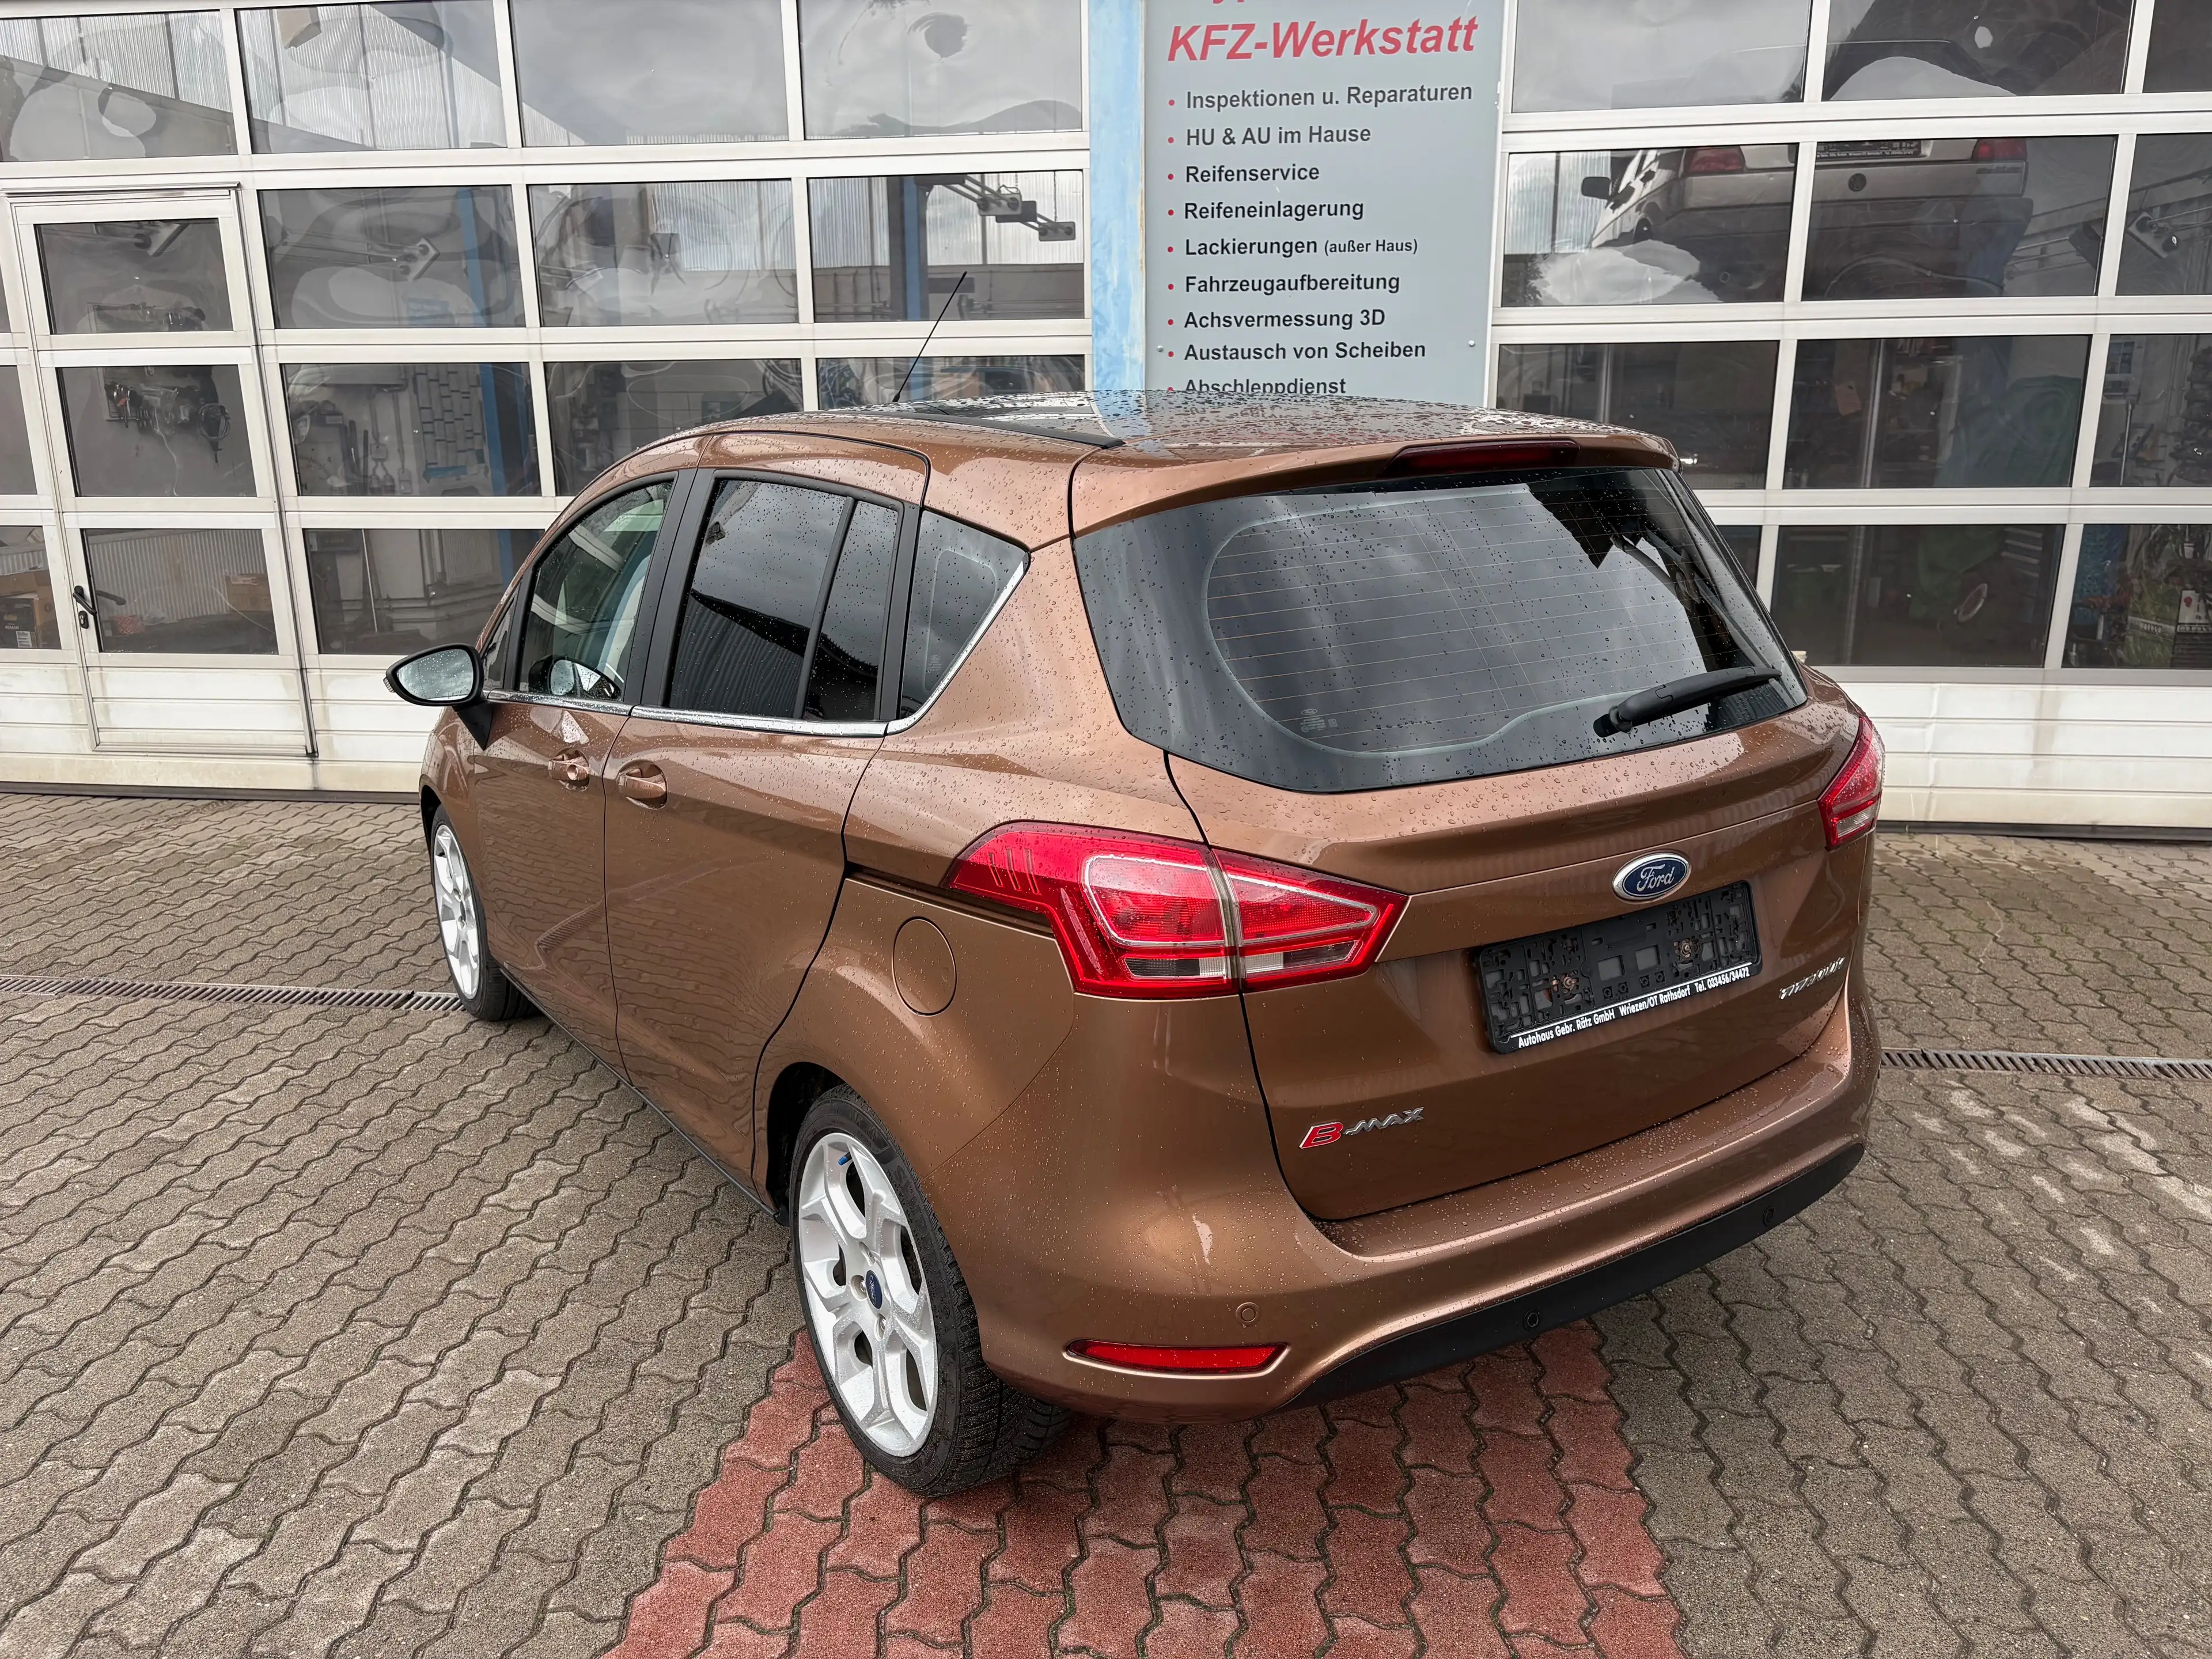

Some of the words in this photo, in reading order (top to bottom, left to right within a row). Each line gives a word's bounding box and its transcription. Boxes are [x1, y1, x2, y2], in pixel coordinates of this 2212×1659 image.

[1167, 16, 1479, 62] KFZ-Werkstatt
[1187, 89, 1315, 112] Inspektionen
[1323, 92, 1339, 105] u.
[1347, 85, 1472, 108] Reparaturen
[1187, 128, 1214, 146] HU
[1222, 127, 1236, 145] &
[1242, 127, 1271, 145] AU
[1278, 127, 1301, 144] im
[1309, 126, 1372, 143] Hause
[1185, 164, 1320, 183] Reifenservice
[1184, 201, 1364, 222] Reifeneinlagerung
[1185, 238, 1318, 258] Lackierungen
[1324, 240, 1372, 256] (außer
[1376, 238, 1418, 255] Haus)
[1185, 274, 1400, 296] Fahrzeugaufbereitung
[1184, 310, 1354, 330] Achsvermessung
[1359, 309, 1386, 326] 3D
[1184, 342, 1286, 361] Austausch
[1293, 346, 1328, 359] von
[1335, 340, 1426, 359] Scheiben
[1637, 863, 1675, 892] Ford
[1518, 1029, 1554, 1048] Autohaus
[1555, 1022, 1575, 1037] Gebr.
[1576, 1016, 1593, 1031] Rätz
[1593, 1009, 1615, 1025] GmbH
[1619, 995, 1658, 1017] Wriezen/OT
[1659, 984, 1691, 1004] Rathsdorf
[1694, 980, 1707, 993] Tel.
[1707, 967, 1750, 990] 033456/34472
